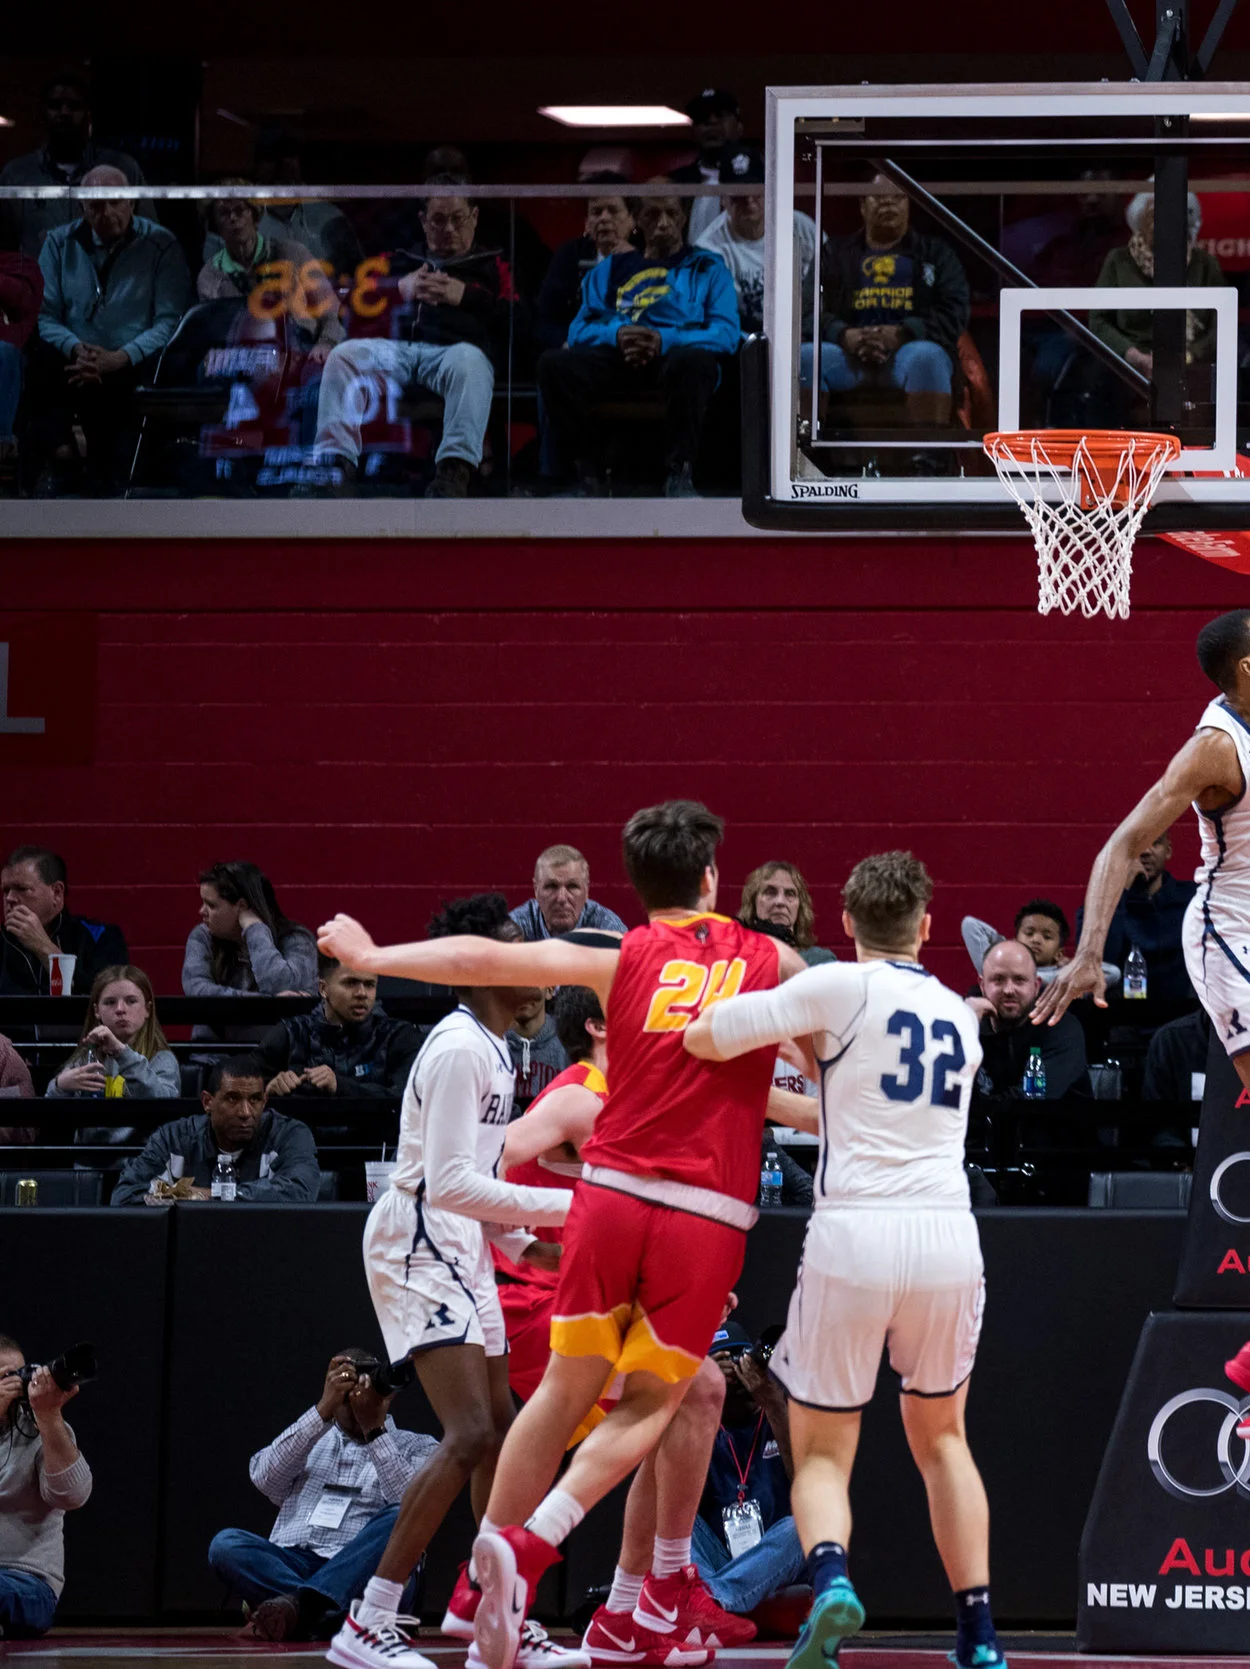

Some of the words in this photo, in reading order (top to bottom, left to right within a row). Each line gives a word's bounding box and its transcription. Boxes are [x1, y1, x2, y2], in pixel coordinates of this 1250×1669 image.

[854, 299, 878, 311] OR
[791, 483, 858, 499] SPALDING
[643, 957, 747, 1033] 24
[880, 1009, 966, 1110] 32
[771, 1074, 804, 1095] ERS
[1086, 1582, 1157, 1609] NEW
